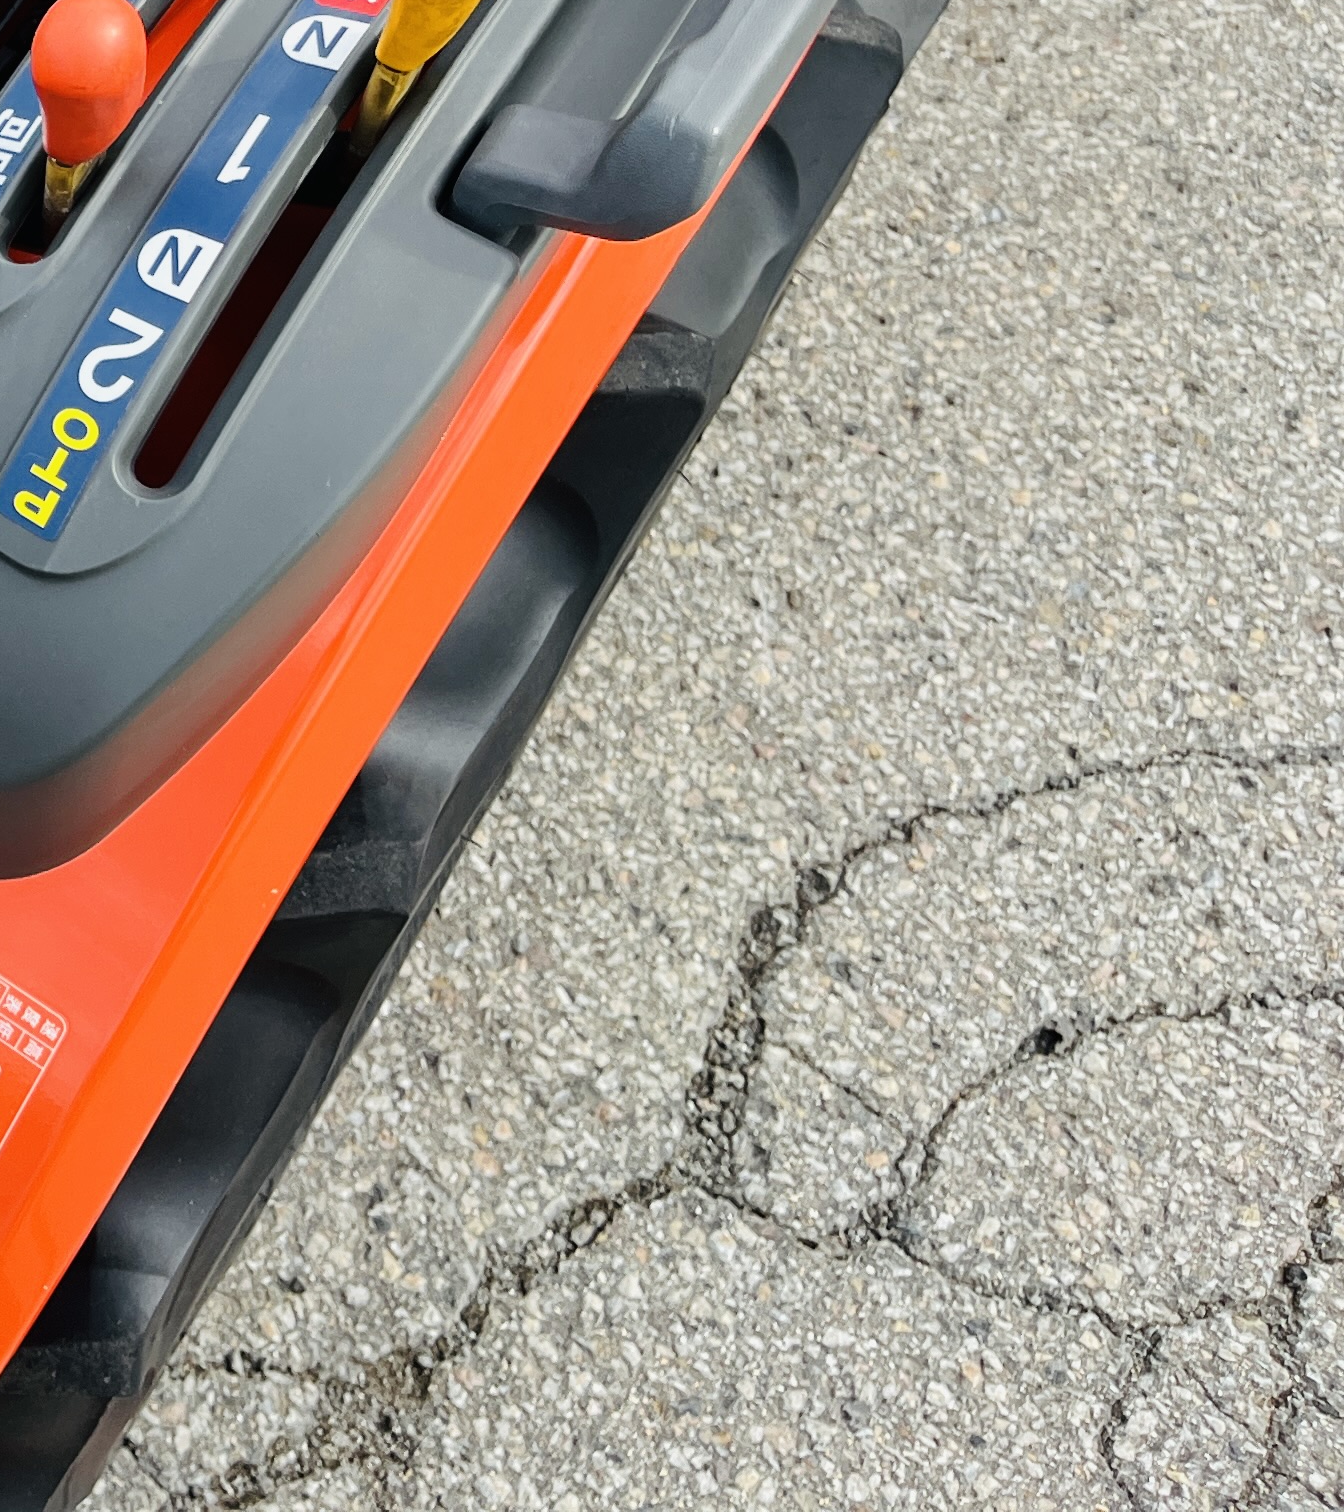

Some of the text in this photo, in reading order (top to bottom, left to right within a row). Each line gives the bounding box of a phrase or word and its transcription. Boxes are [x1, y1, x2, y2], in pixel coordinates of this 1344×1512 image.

[293, 20, 348, 58] N
[216, 113, 270, 183] 1
[147, 235, 203, 286] N
[78, 306, 164, 404] 2
[12, 407, 99, 528] PTO
